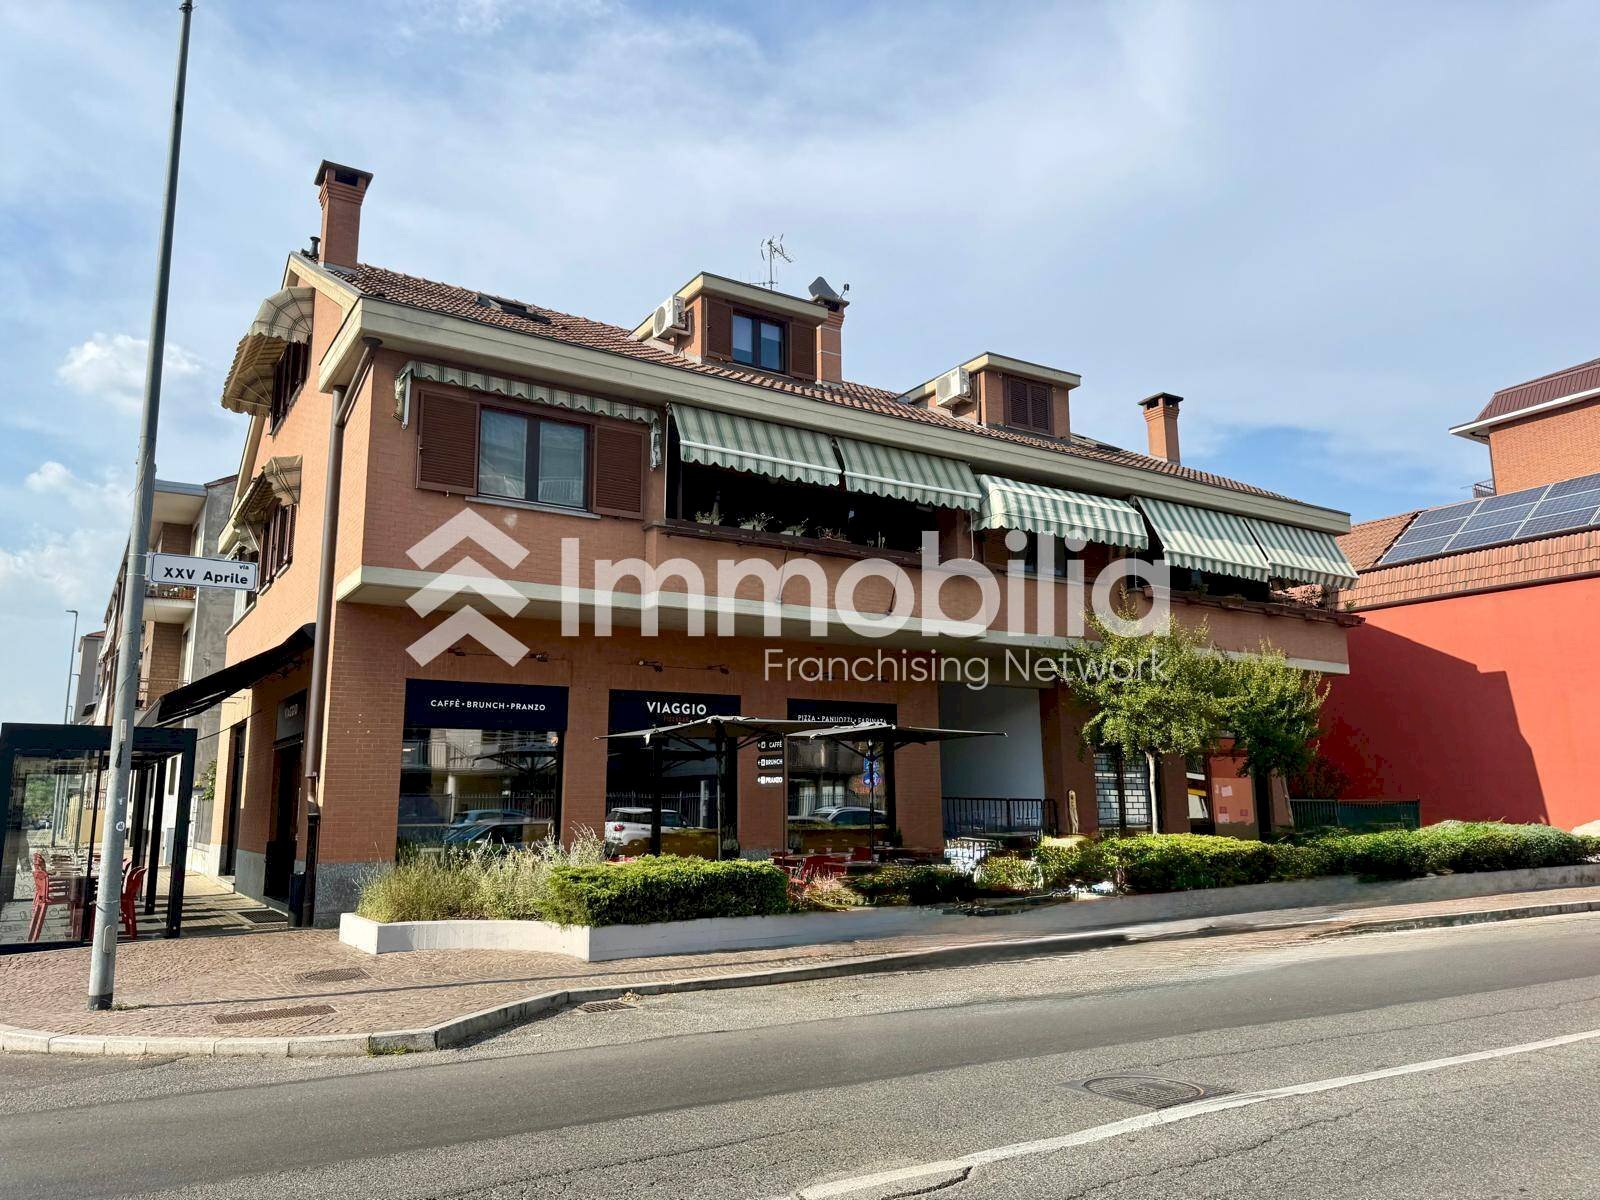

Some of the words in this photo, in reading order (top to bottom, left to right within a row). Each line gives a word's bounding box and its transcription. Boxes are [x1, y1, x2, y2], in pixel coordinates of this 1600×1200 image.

[164, 567, 195, 579] XXV
[203, 571, 248, 584] Aprile
[430, 699, 460, 708] CAFFÈ
[466, 701, 505, 709] BRUNCH
[510, 703, 546, 711] PRANZO
[646, 701, 707, 715] VIAGGIO
[797, 714, 816, 722] PIZZA
